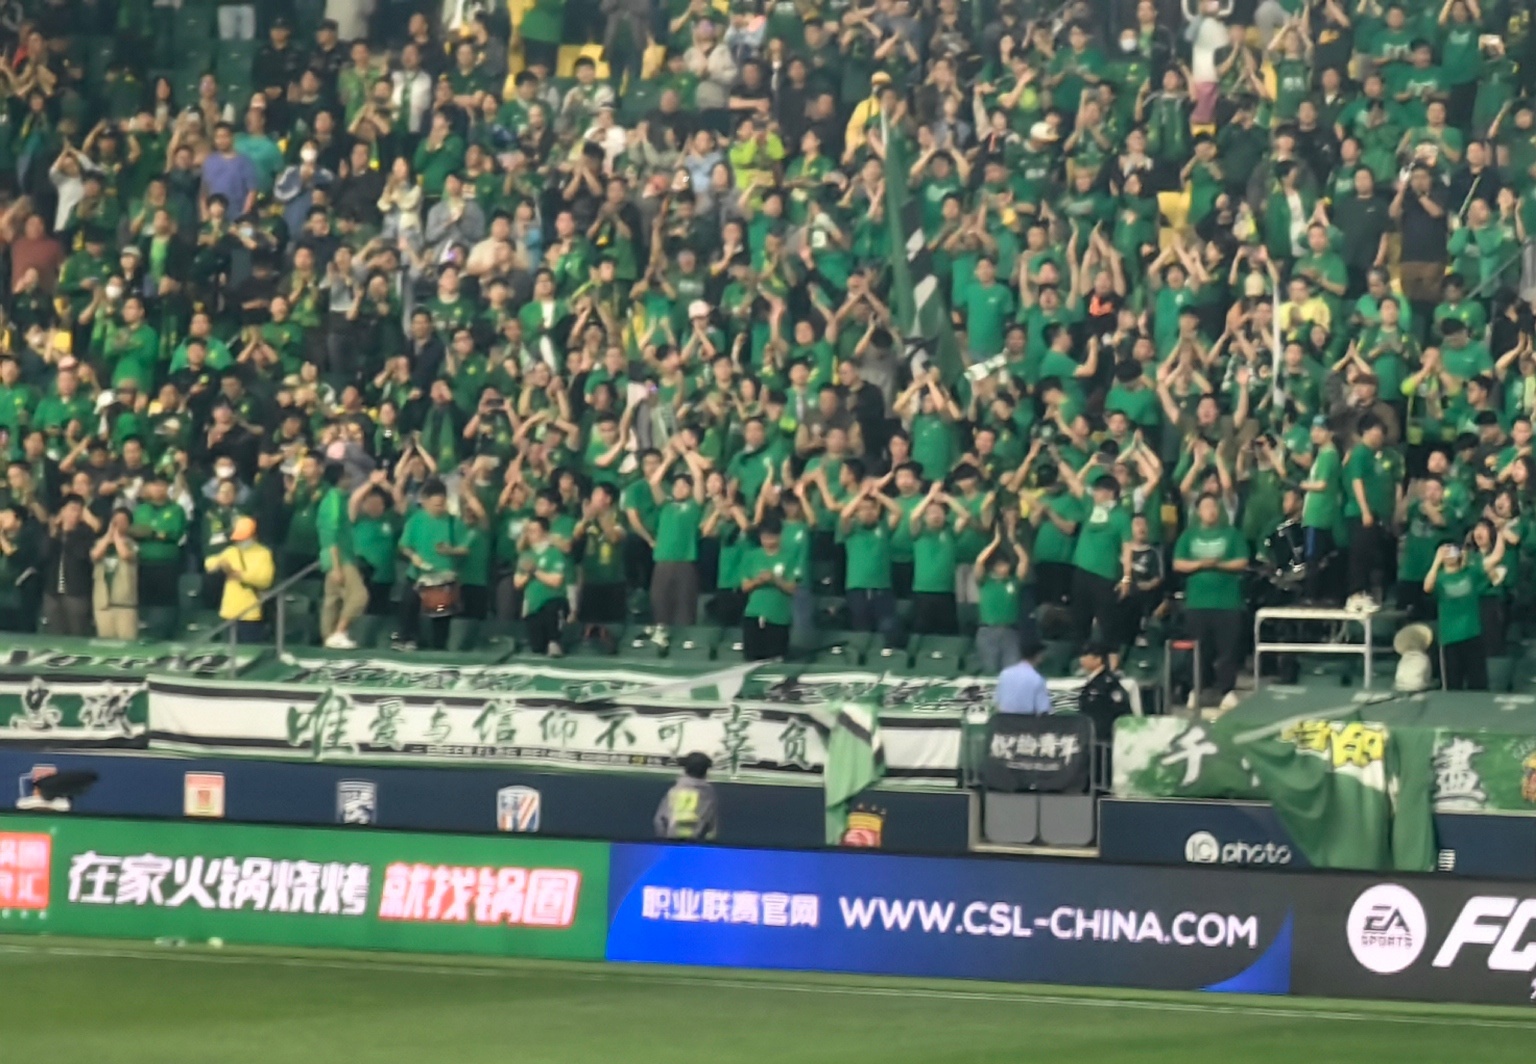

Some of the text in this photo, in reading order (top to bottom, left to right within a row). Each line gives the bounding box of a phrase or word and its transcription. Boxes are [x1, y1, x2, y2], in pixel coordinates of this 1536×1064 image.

[1221, 840, 1292, 865] photo
[68, 851, 371, 916] 在家火锅烧烤
[379, 863, 580, 927] 就找锅圈
[641, 886, 819, 927] 职业联赛官网
[839, 897, 1259, 949] WWW.CSL-CHINA.COM
[1363, 905, 1411, 932] EA
[1361, 934, 1413, 948] SPORTS
